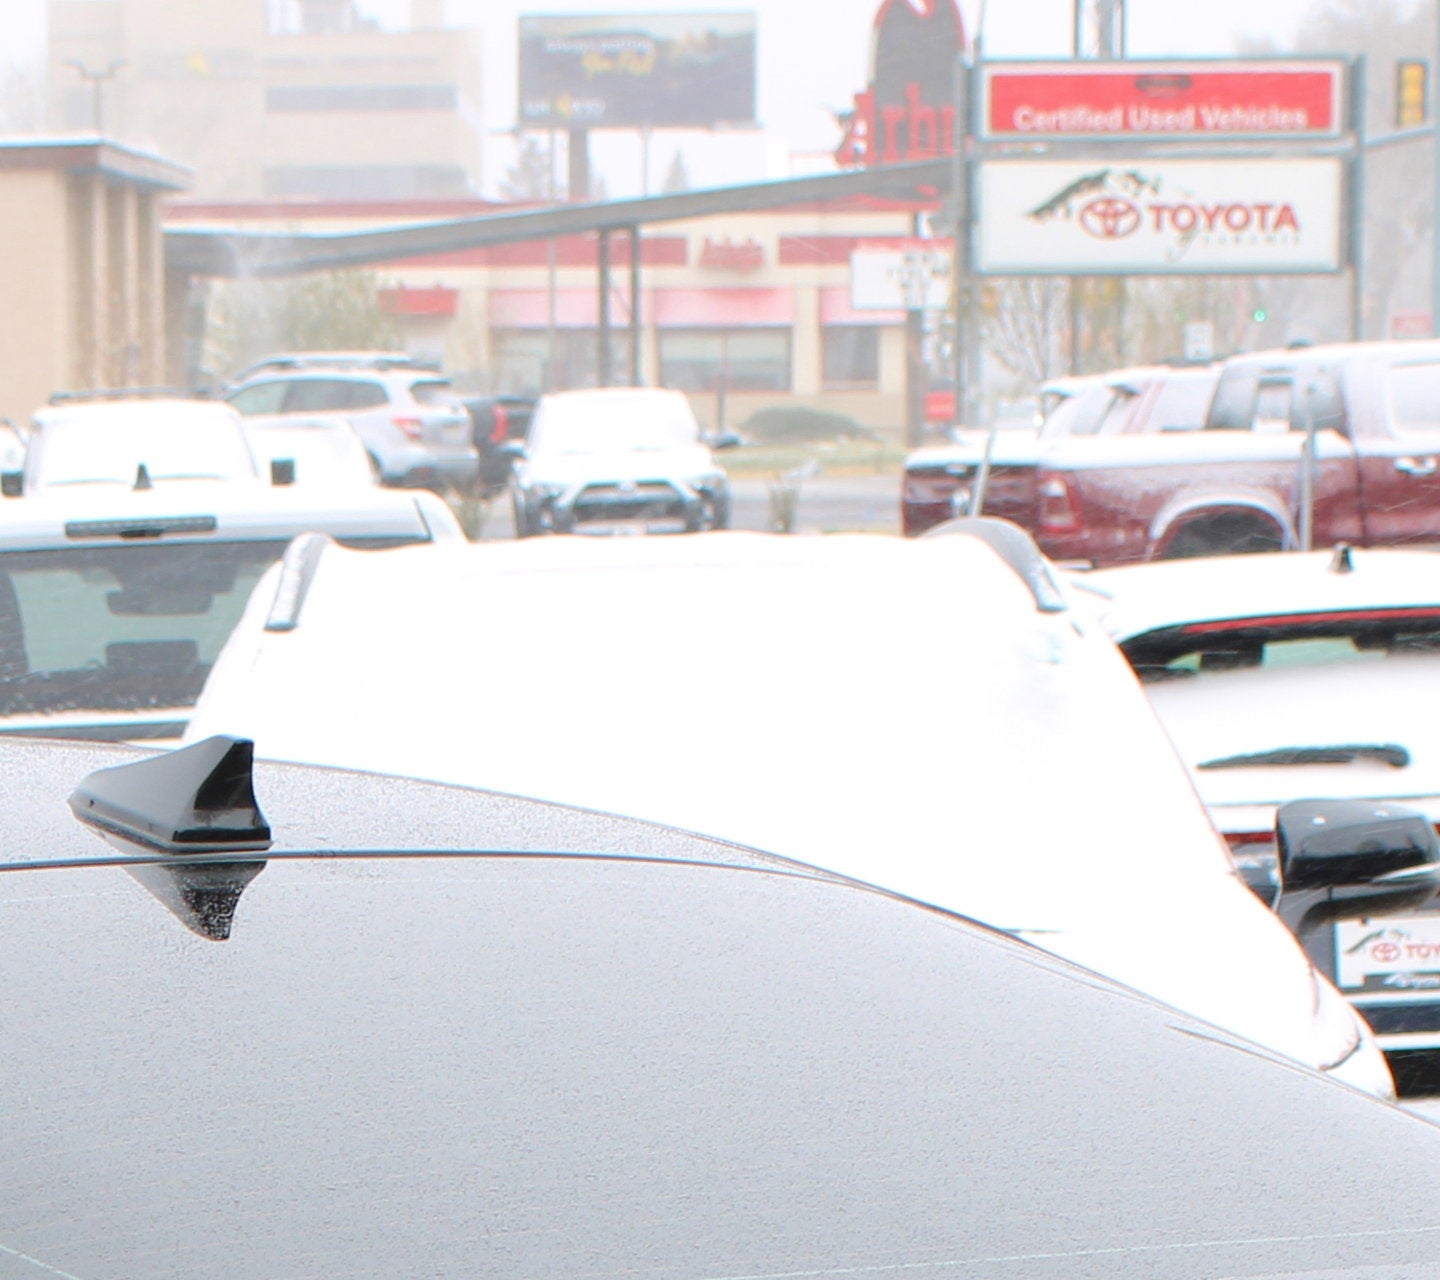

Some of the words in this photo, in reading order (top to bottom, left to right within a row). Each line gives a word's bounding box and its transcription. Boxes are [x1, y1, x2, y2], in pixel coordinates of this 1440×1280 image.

[1014, 105, 1123, 132] Certified
[1129, 105, 1195, 131] Used
[1200, 102, 1308, 130] Vehicles
[1148, 203, 1300, 233] TOYOTA
